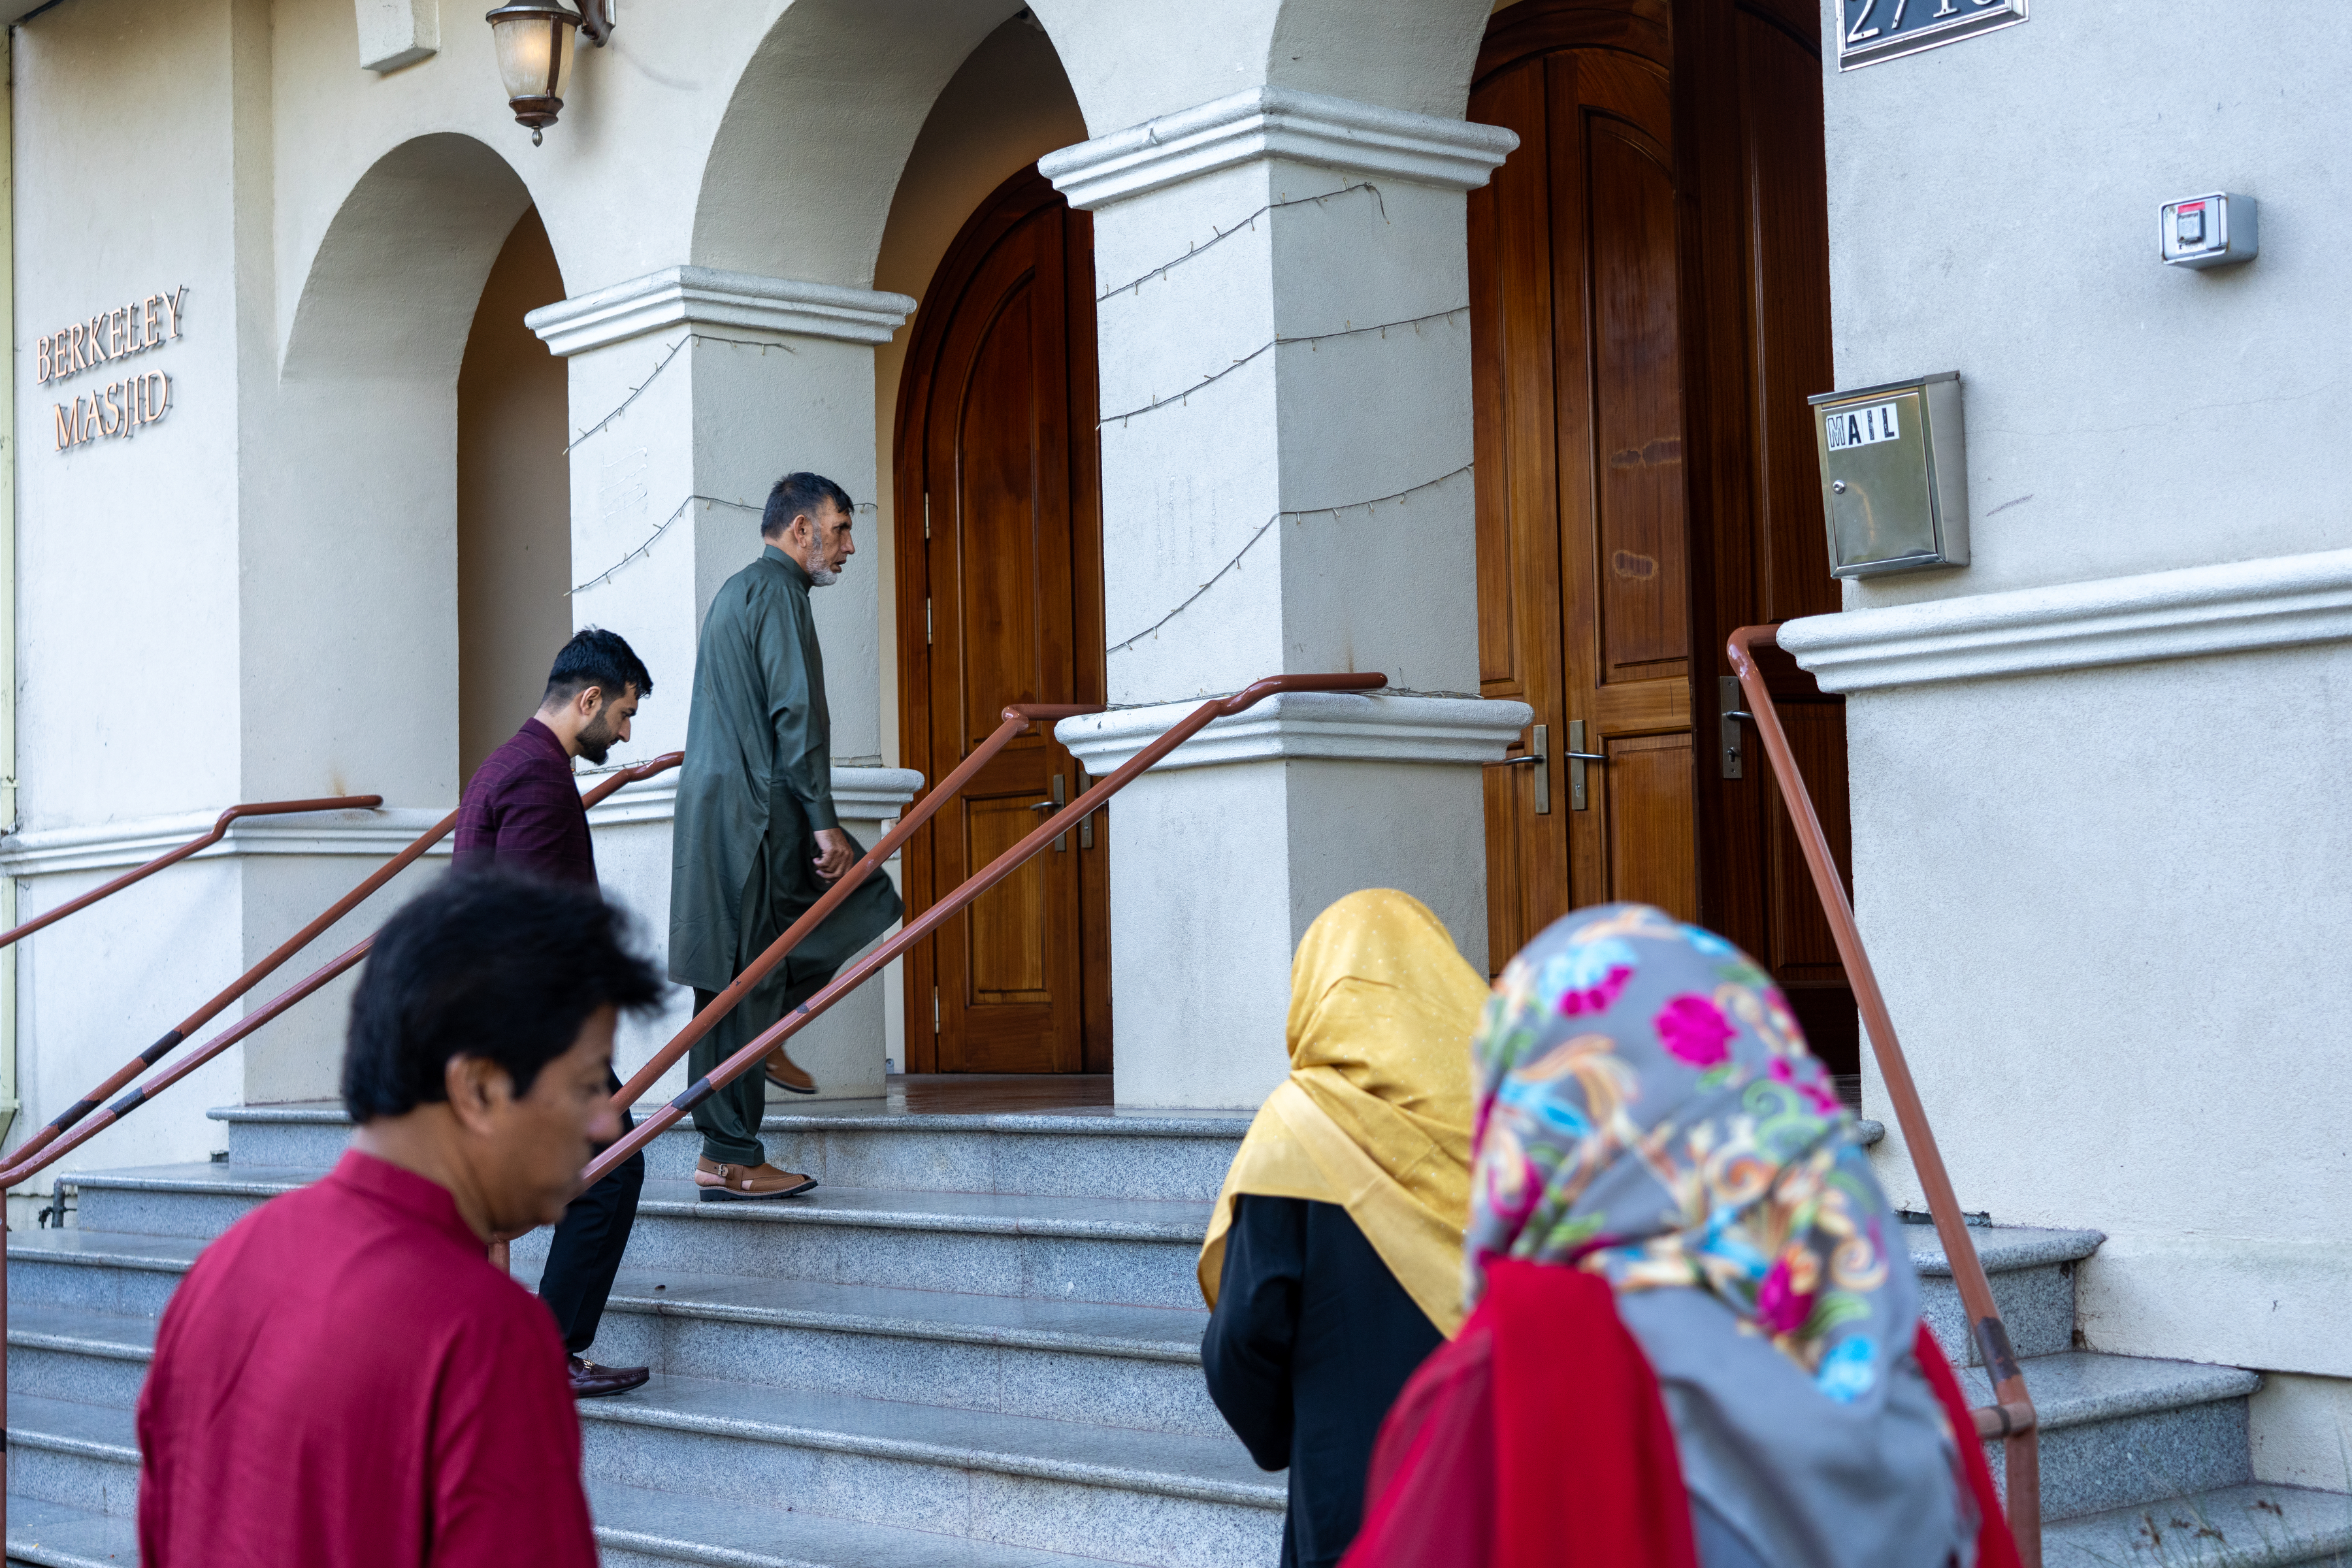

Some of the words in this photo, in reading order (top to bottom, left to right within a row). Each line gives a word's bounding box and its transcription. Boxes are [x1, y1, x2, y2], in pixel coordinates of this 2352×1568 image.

[37, 284, 183, 385] BERKELEY
[54, 368, 168, 451] MASJID
[1827, 407, 1895, 448] MAIL
